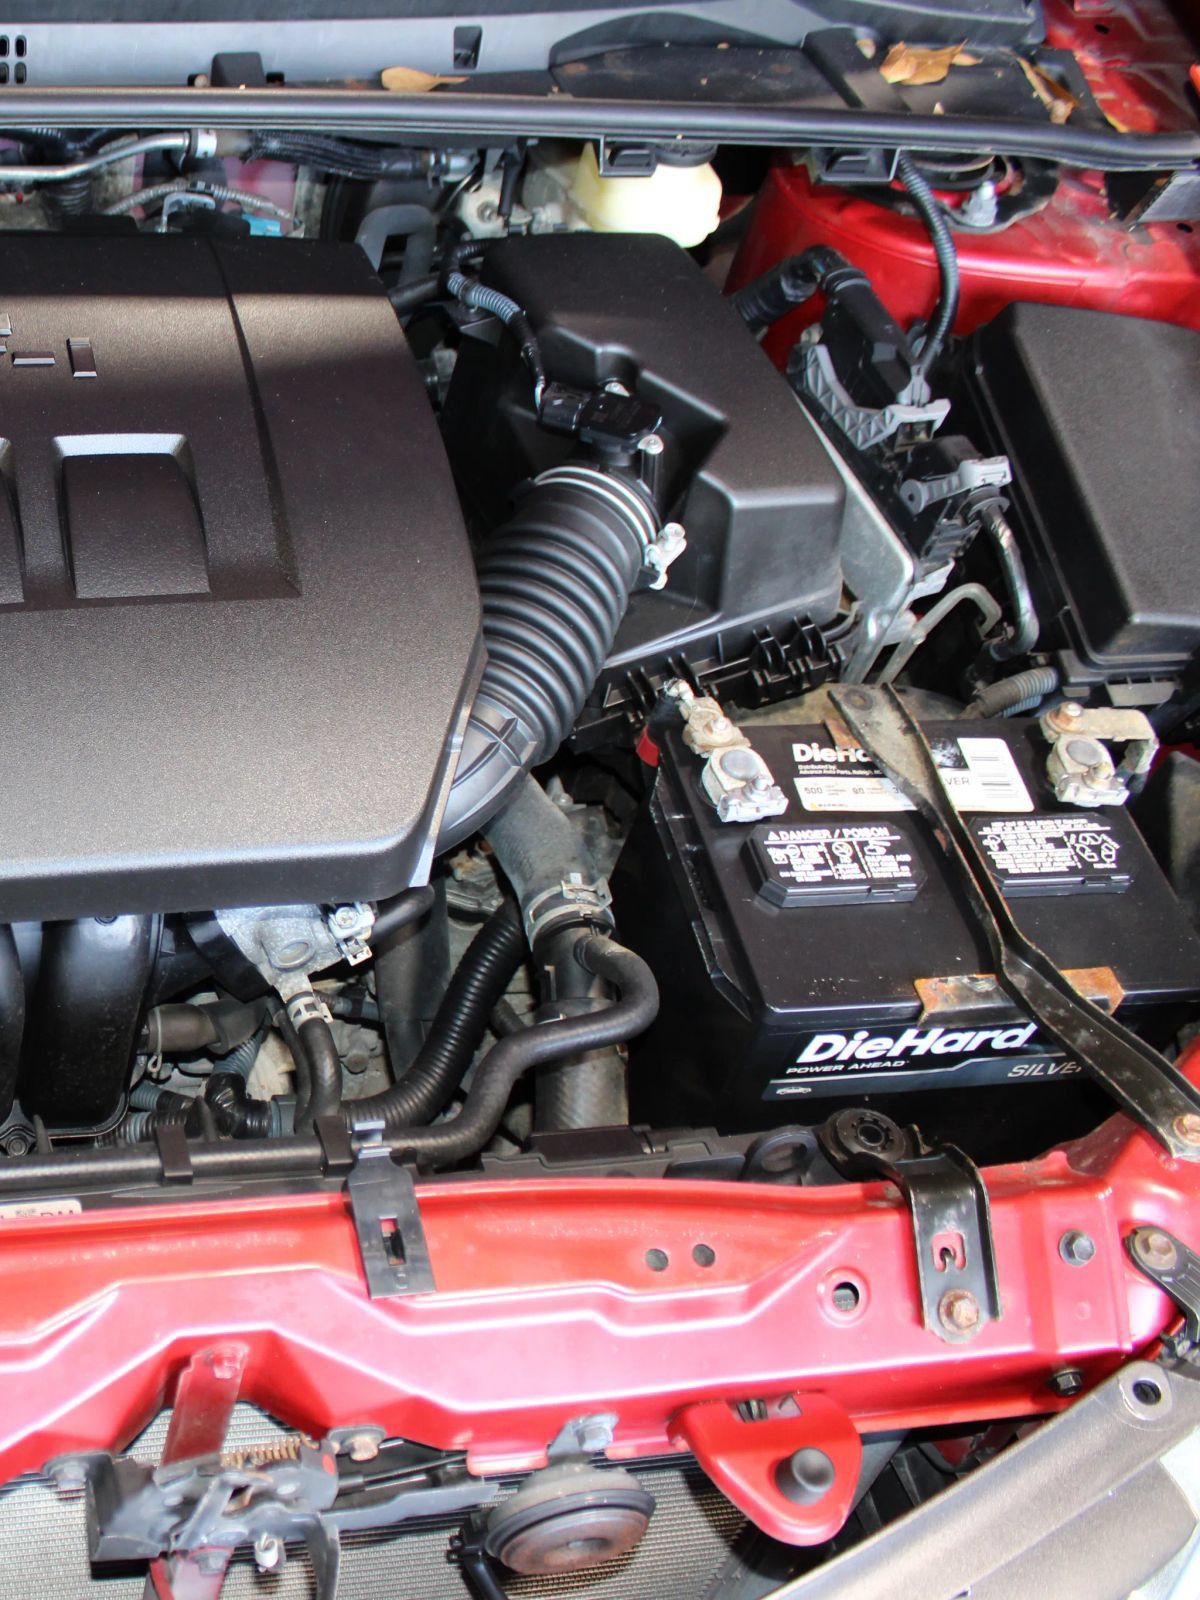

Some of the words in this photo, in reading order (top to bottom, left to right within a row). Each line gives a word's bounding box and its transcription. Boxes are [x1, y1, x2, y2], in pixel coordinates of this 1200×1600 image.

[779, 829, 832, 841] DANGER
[843, 827, 890, 838] POISON
[797, 1022, 1039, 1063] DieHard
[786, 1063, 844, 1075] POWER
[847, 1060, 906, 1071] AHEAD
